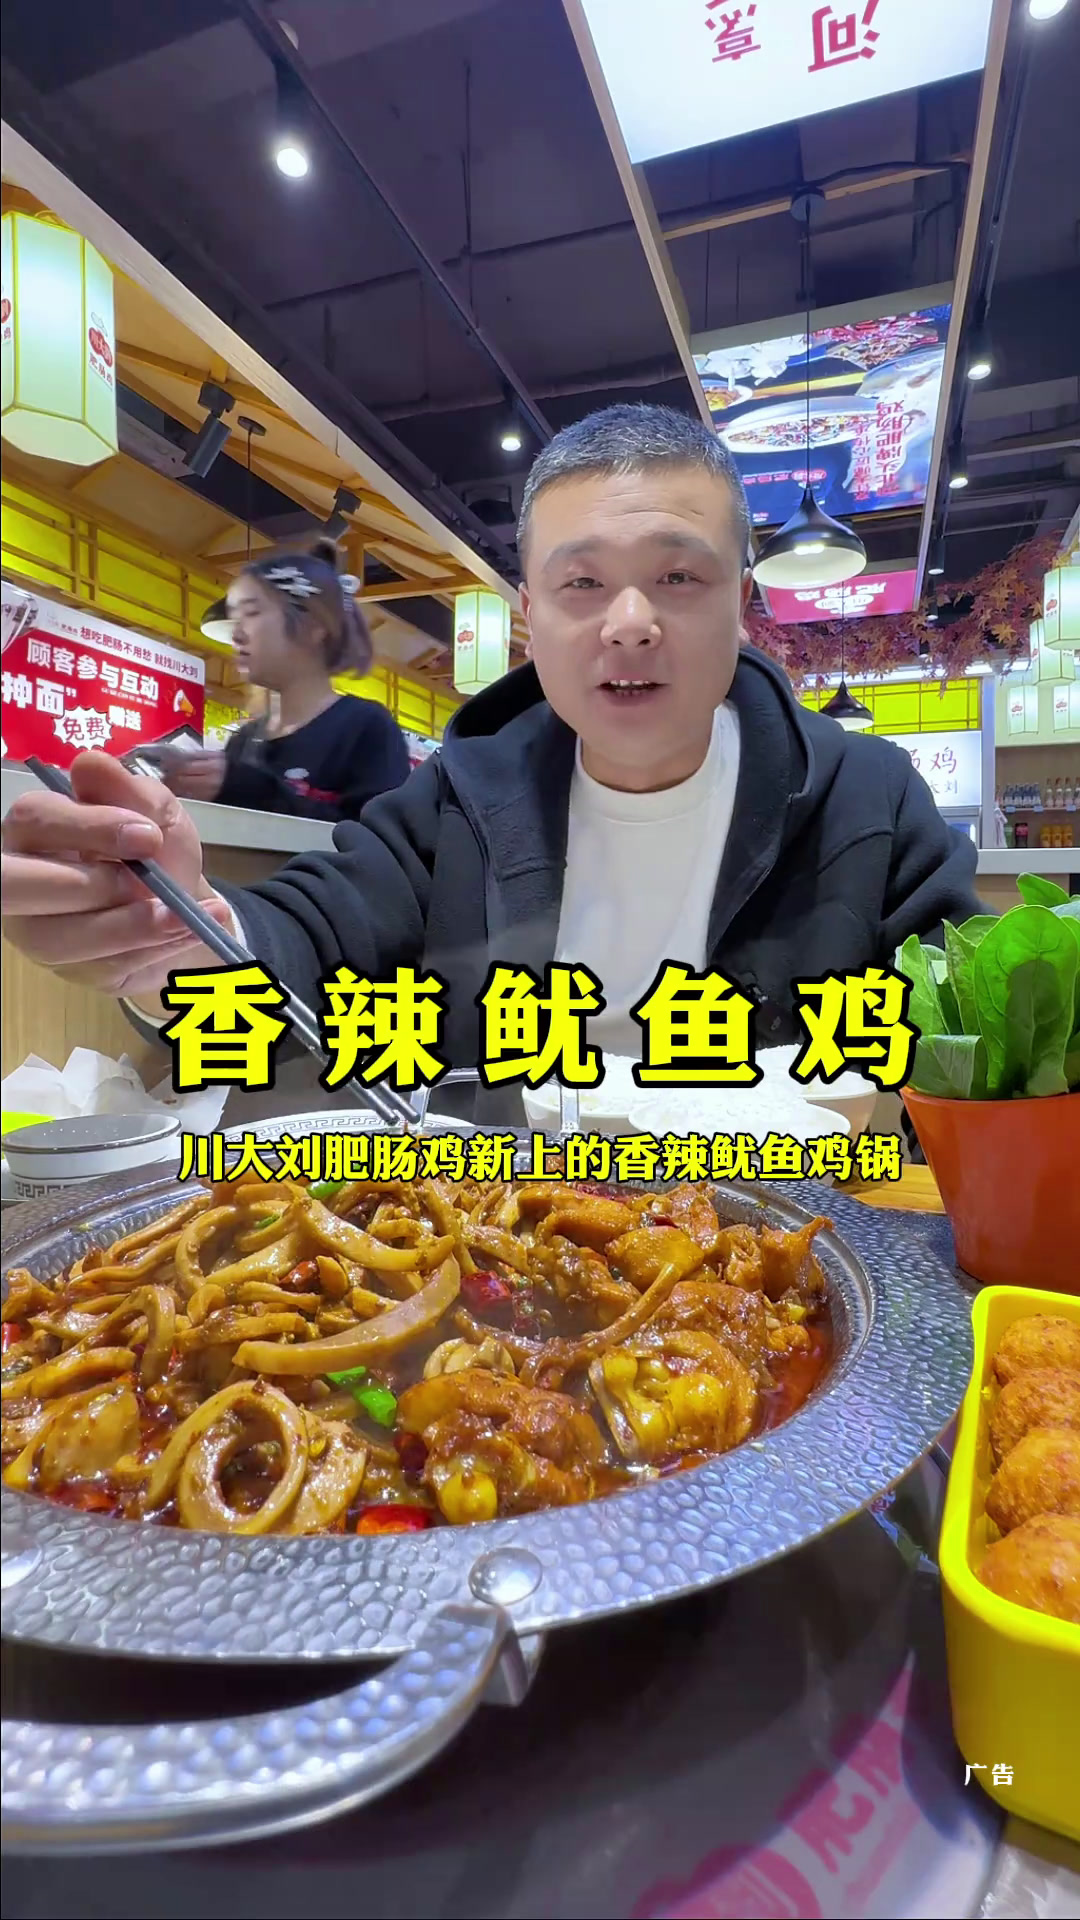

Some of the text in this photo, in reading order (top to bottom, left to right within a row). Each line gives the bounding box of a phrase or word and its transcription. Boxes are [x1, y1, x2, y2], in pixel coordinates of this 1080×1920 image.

[704, 1, 761, 63] 烹
[27, 638, 159, 701] 顾客参与互动
[80, 625, 153, 662] 想吃肥肠不用愁
[154, 653, 198, 679] 就找川大刘
[63, 717, 105, 740] 免费
